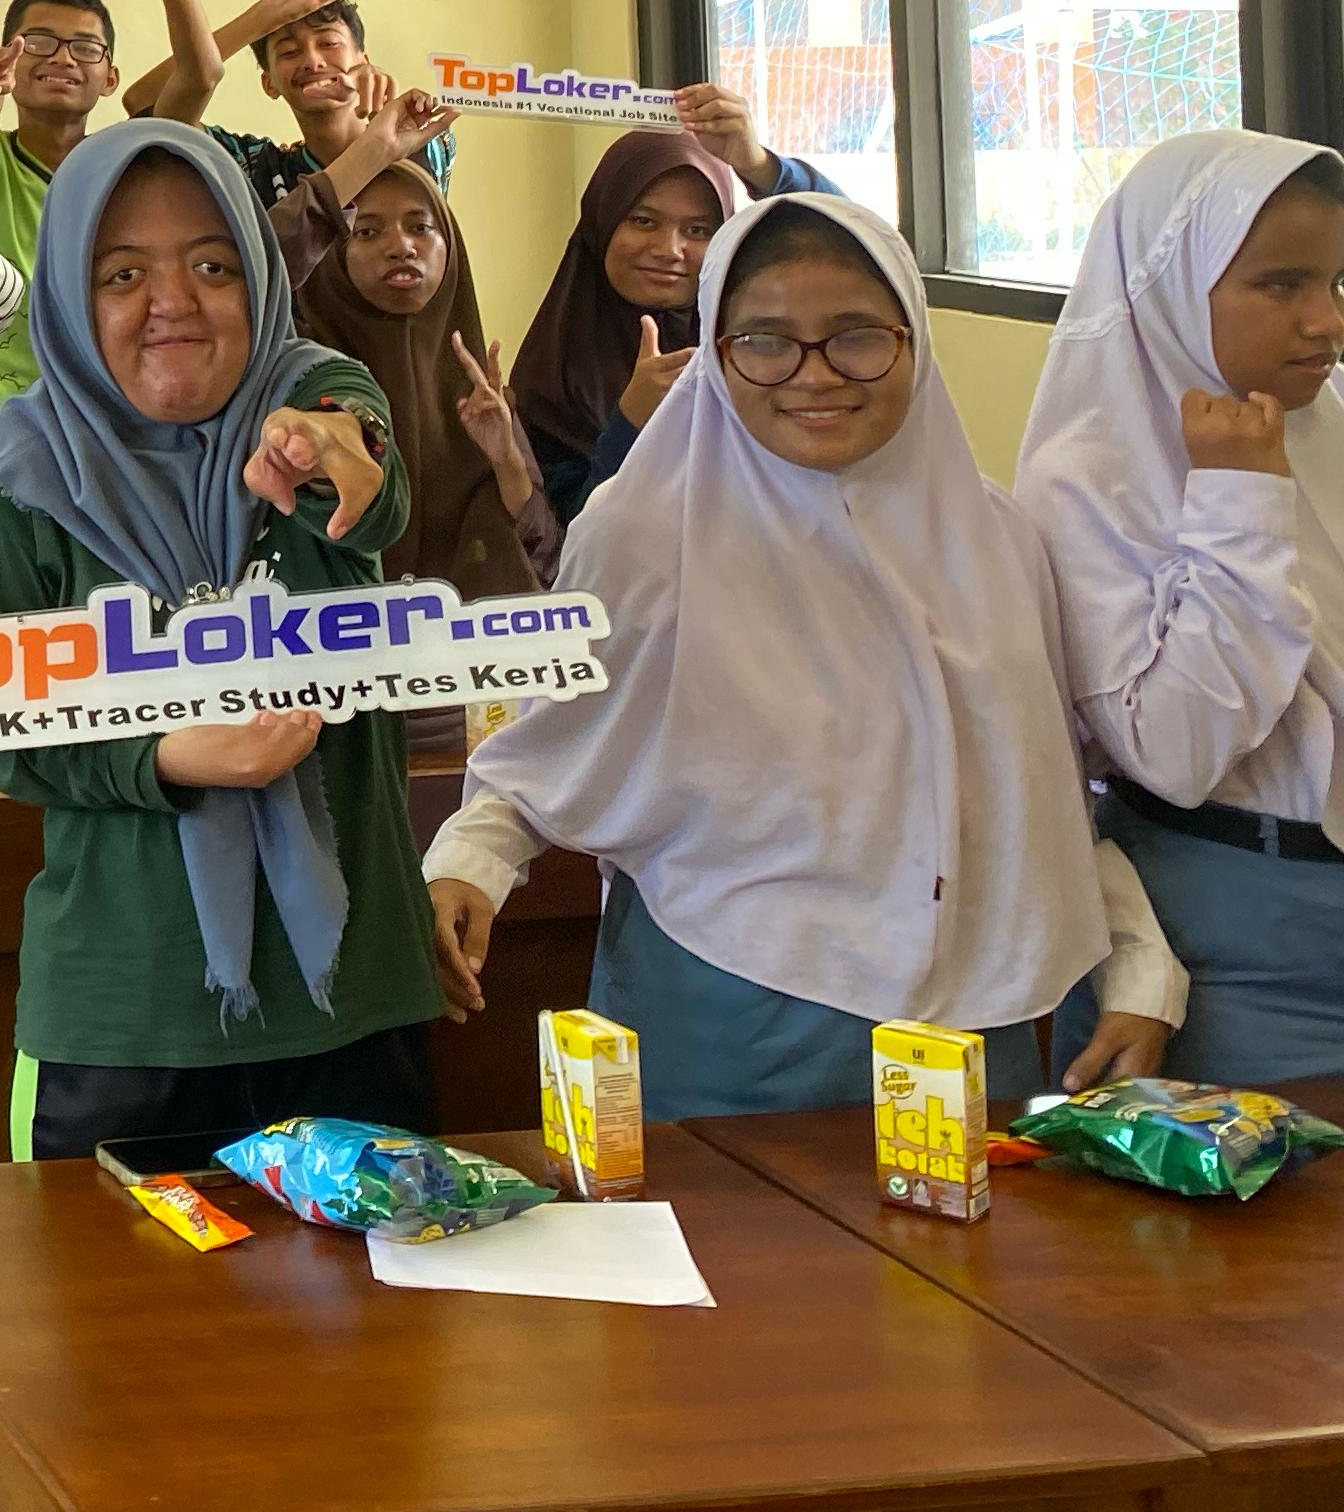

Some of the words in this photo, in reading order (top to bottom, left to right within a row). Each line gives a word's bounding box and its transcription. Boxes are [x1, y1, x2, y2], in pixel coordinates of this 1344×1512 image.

[433, 58, 678, 105] TopLoker.com
[441, 95, 512, 109] Indonesia
[516, 101, 532, 111] #1
[537, 103, 615, 118] Vocational
[619, 109, 645, 120] Job
[649, 111, 678, 123] Site
[470, 656, 596, 692] Kerja
